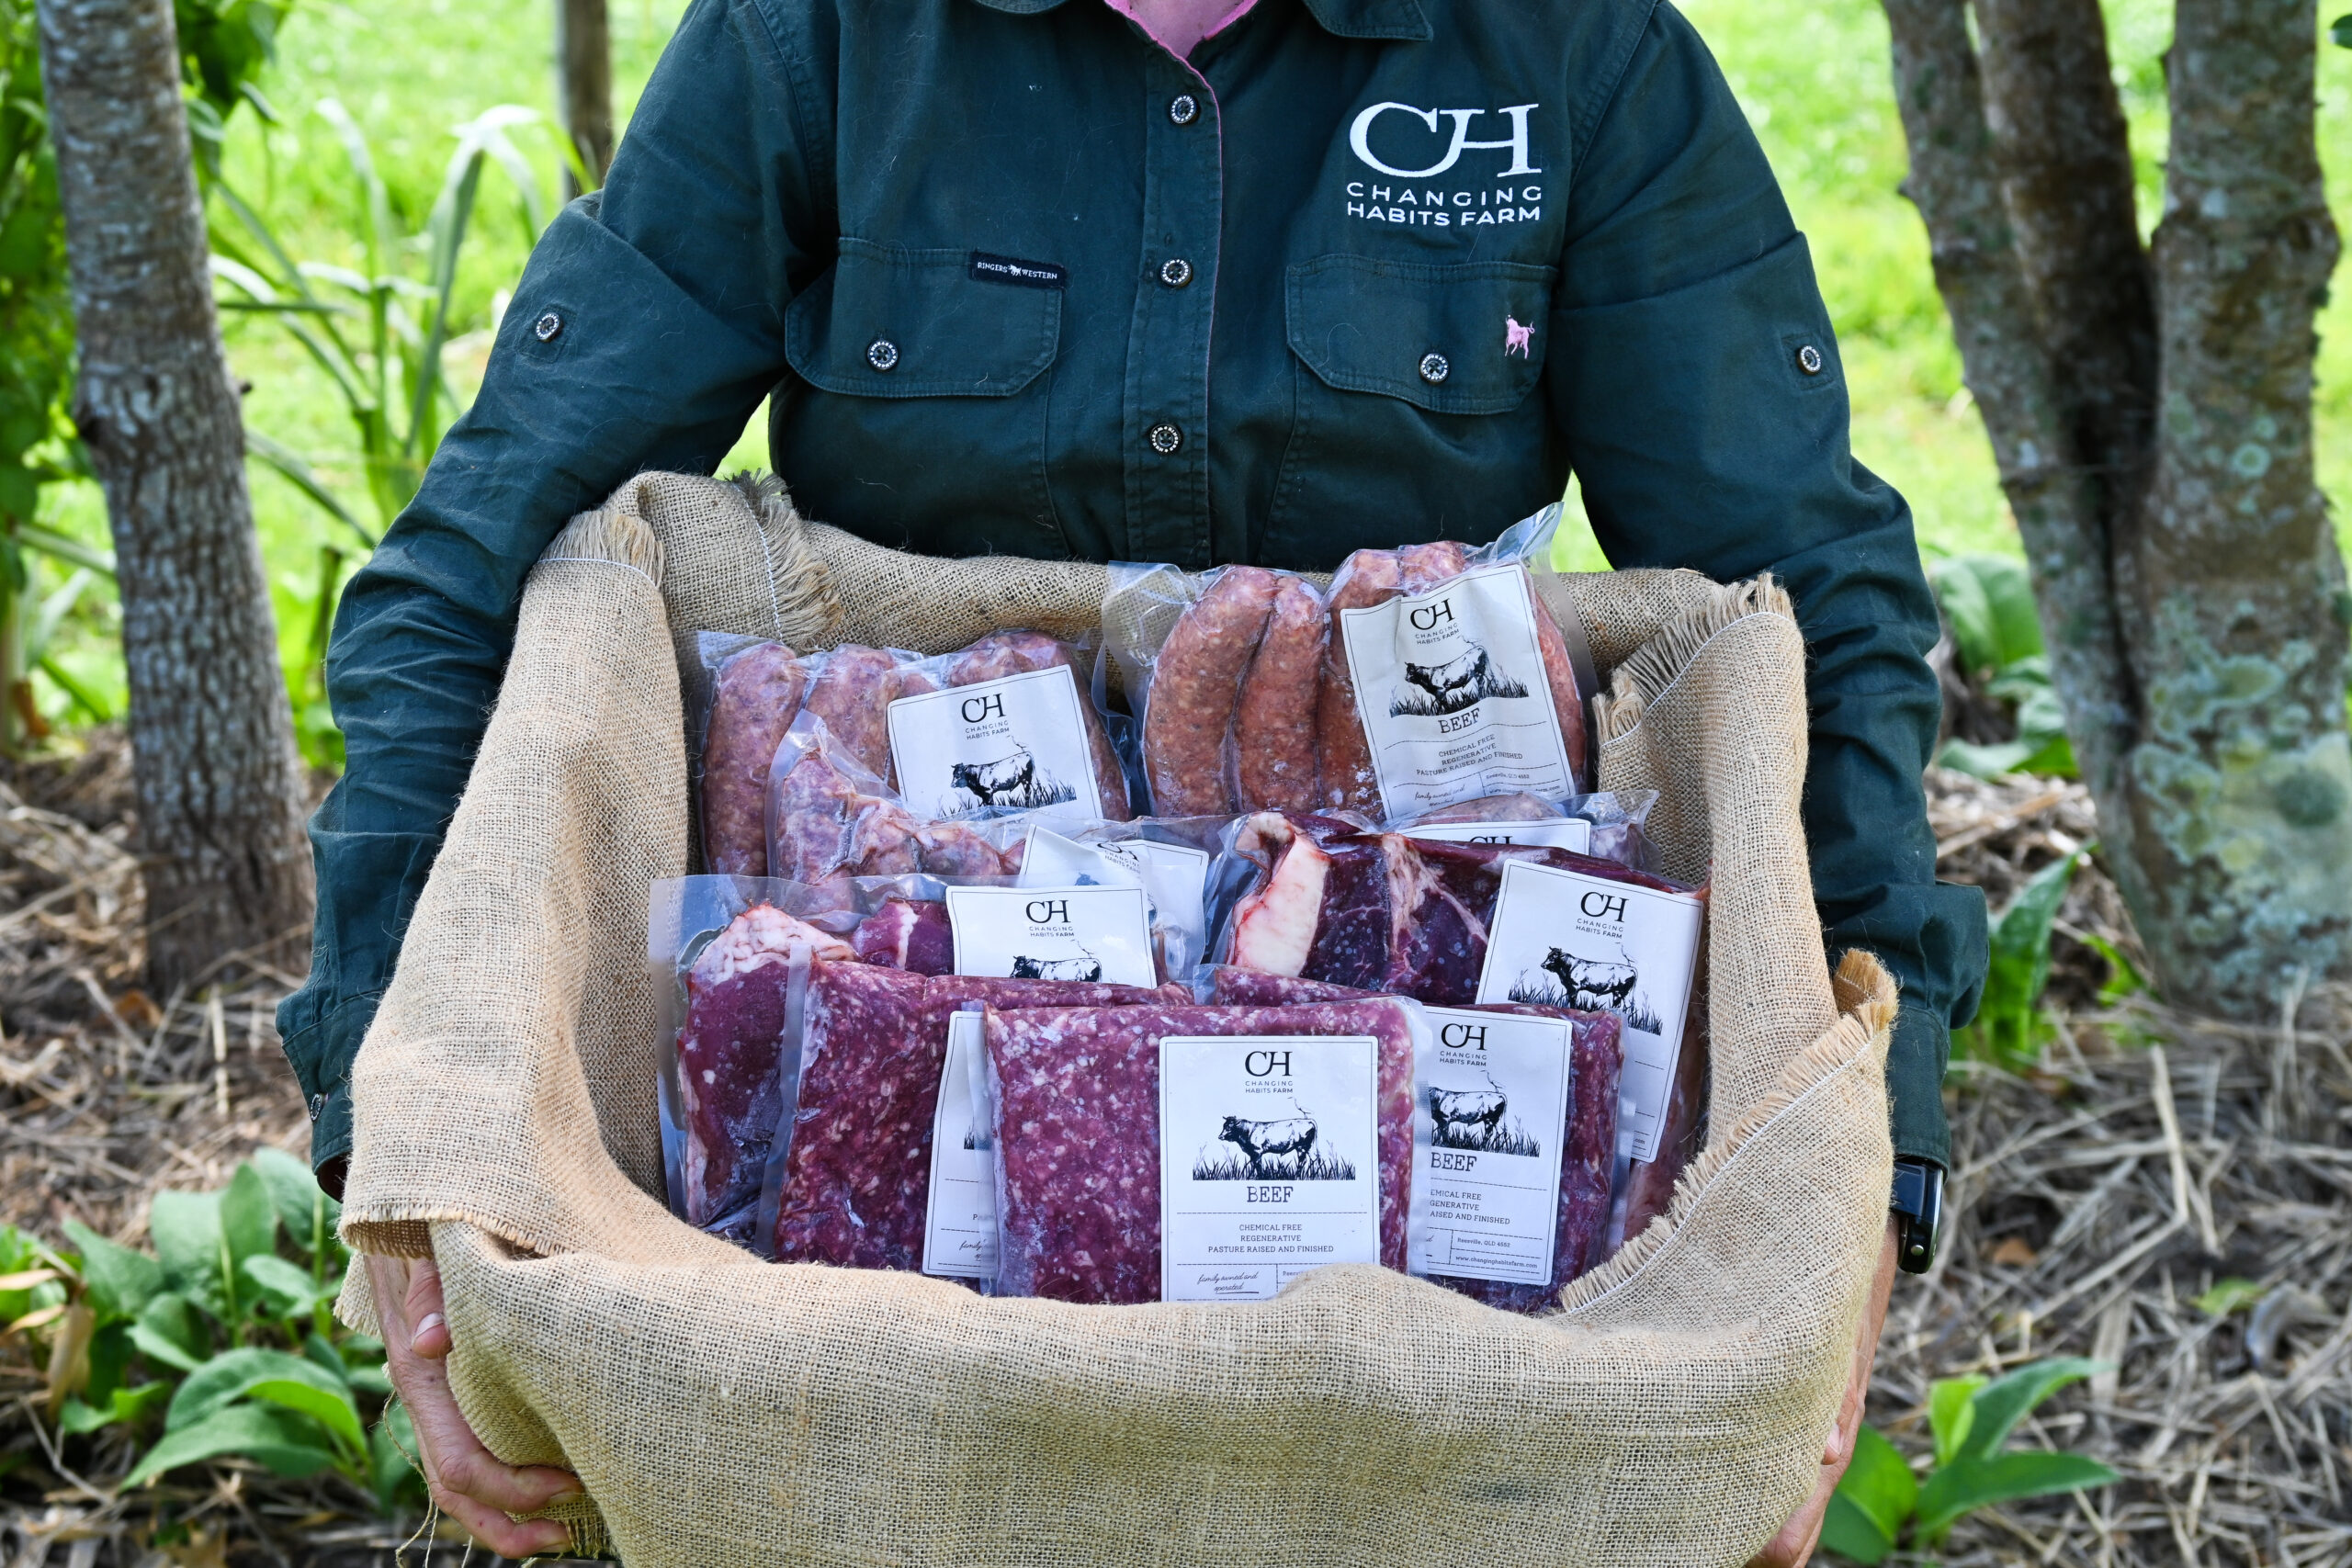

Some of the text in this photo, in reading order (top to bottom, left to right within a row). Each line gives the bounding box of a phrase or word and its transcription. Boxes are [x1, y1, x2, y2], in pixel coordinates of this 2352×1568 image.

[1350, 102, 1543, 177] CH
[1347, 183, 1542, 206] CHANGING
[1347, 201, 1541, 226] HABITS FARM
[978, 262, 1058, 279] RINGERS WESTERN
[1410, 598, 1455, 631] CH
[1415, 622, 1458, 639] CHANGING
[1442, 628, 1459, 640] FARM
[961, 693, 1007, 724] CH
[965, 720, 1009, 734] CHANGING
[1438, 708, 1481, 734] BEEF
[967, 728, 1010, 739] HABITS FARM
[1438, 734, 1496, 758] CHEMICAL FREE
[1442, 743, 1497, 766] REGENERATIVE
[1416, 751, 1523, 776] PASTURE RAISED AND FINISHED
[1025, 899, 1071, 924] CH
[1580, 891, 1630, 923] CH
[1576, 925, 1623, 939] HABITS FARM
[1577, 918, 1623, 932] CHANGING
[1441, 1022, 1489, 1051] CH
[1440, 1050, 1487, 1060] CHANGING
[1440, 1057, 1464, 1066] HABITS
[1244, 1051, 1293, 1077] CH
[1430, 1152, 1478, 1172] BEEF
[1247, 1186, 1294, 1203] BEEF
[1430, 1189, 1482, 1201] EMICAL FREE
[1430, 1200, 1480, 1211] GENERATIVE
[1430, 1211, 1453, 1219] AISED
[1474, 1215, 1510, 1225] FINISHED
[1238, 1224, 1281, 1232] CHEMICAL
[1197, 1271, 1260, 1284] family owned and
[1214, 1282, 1245, 1292] operated
